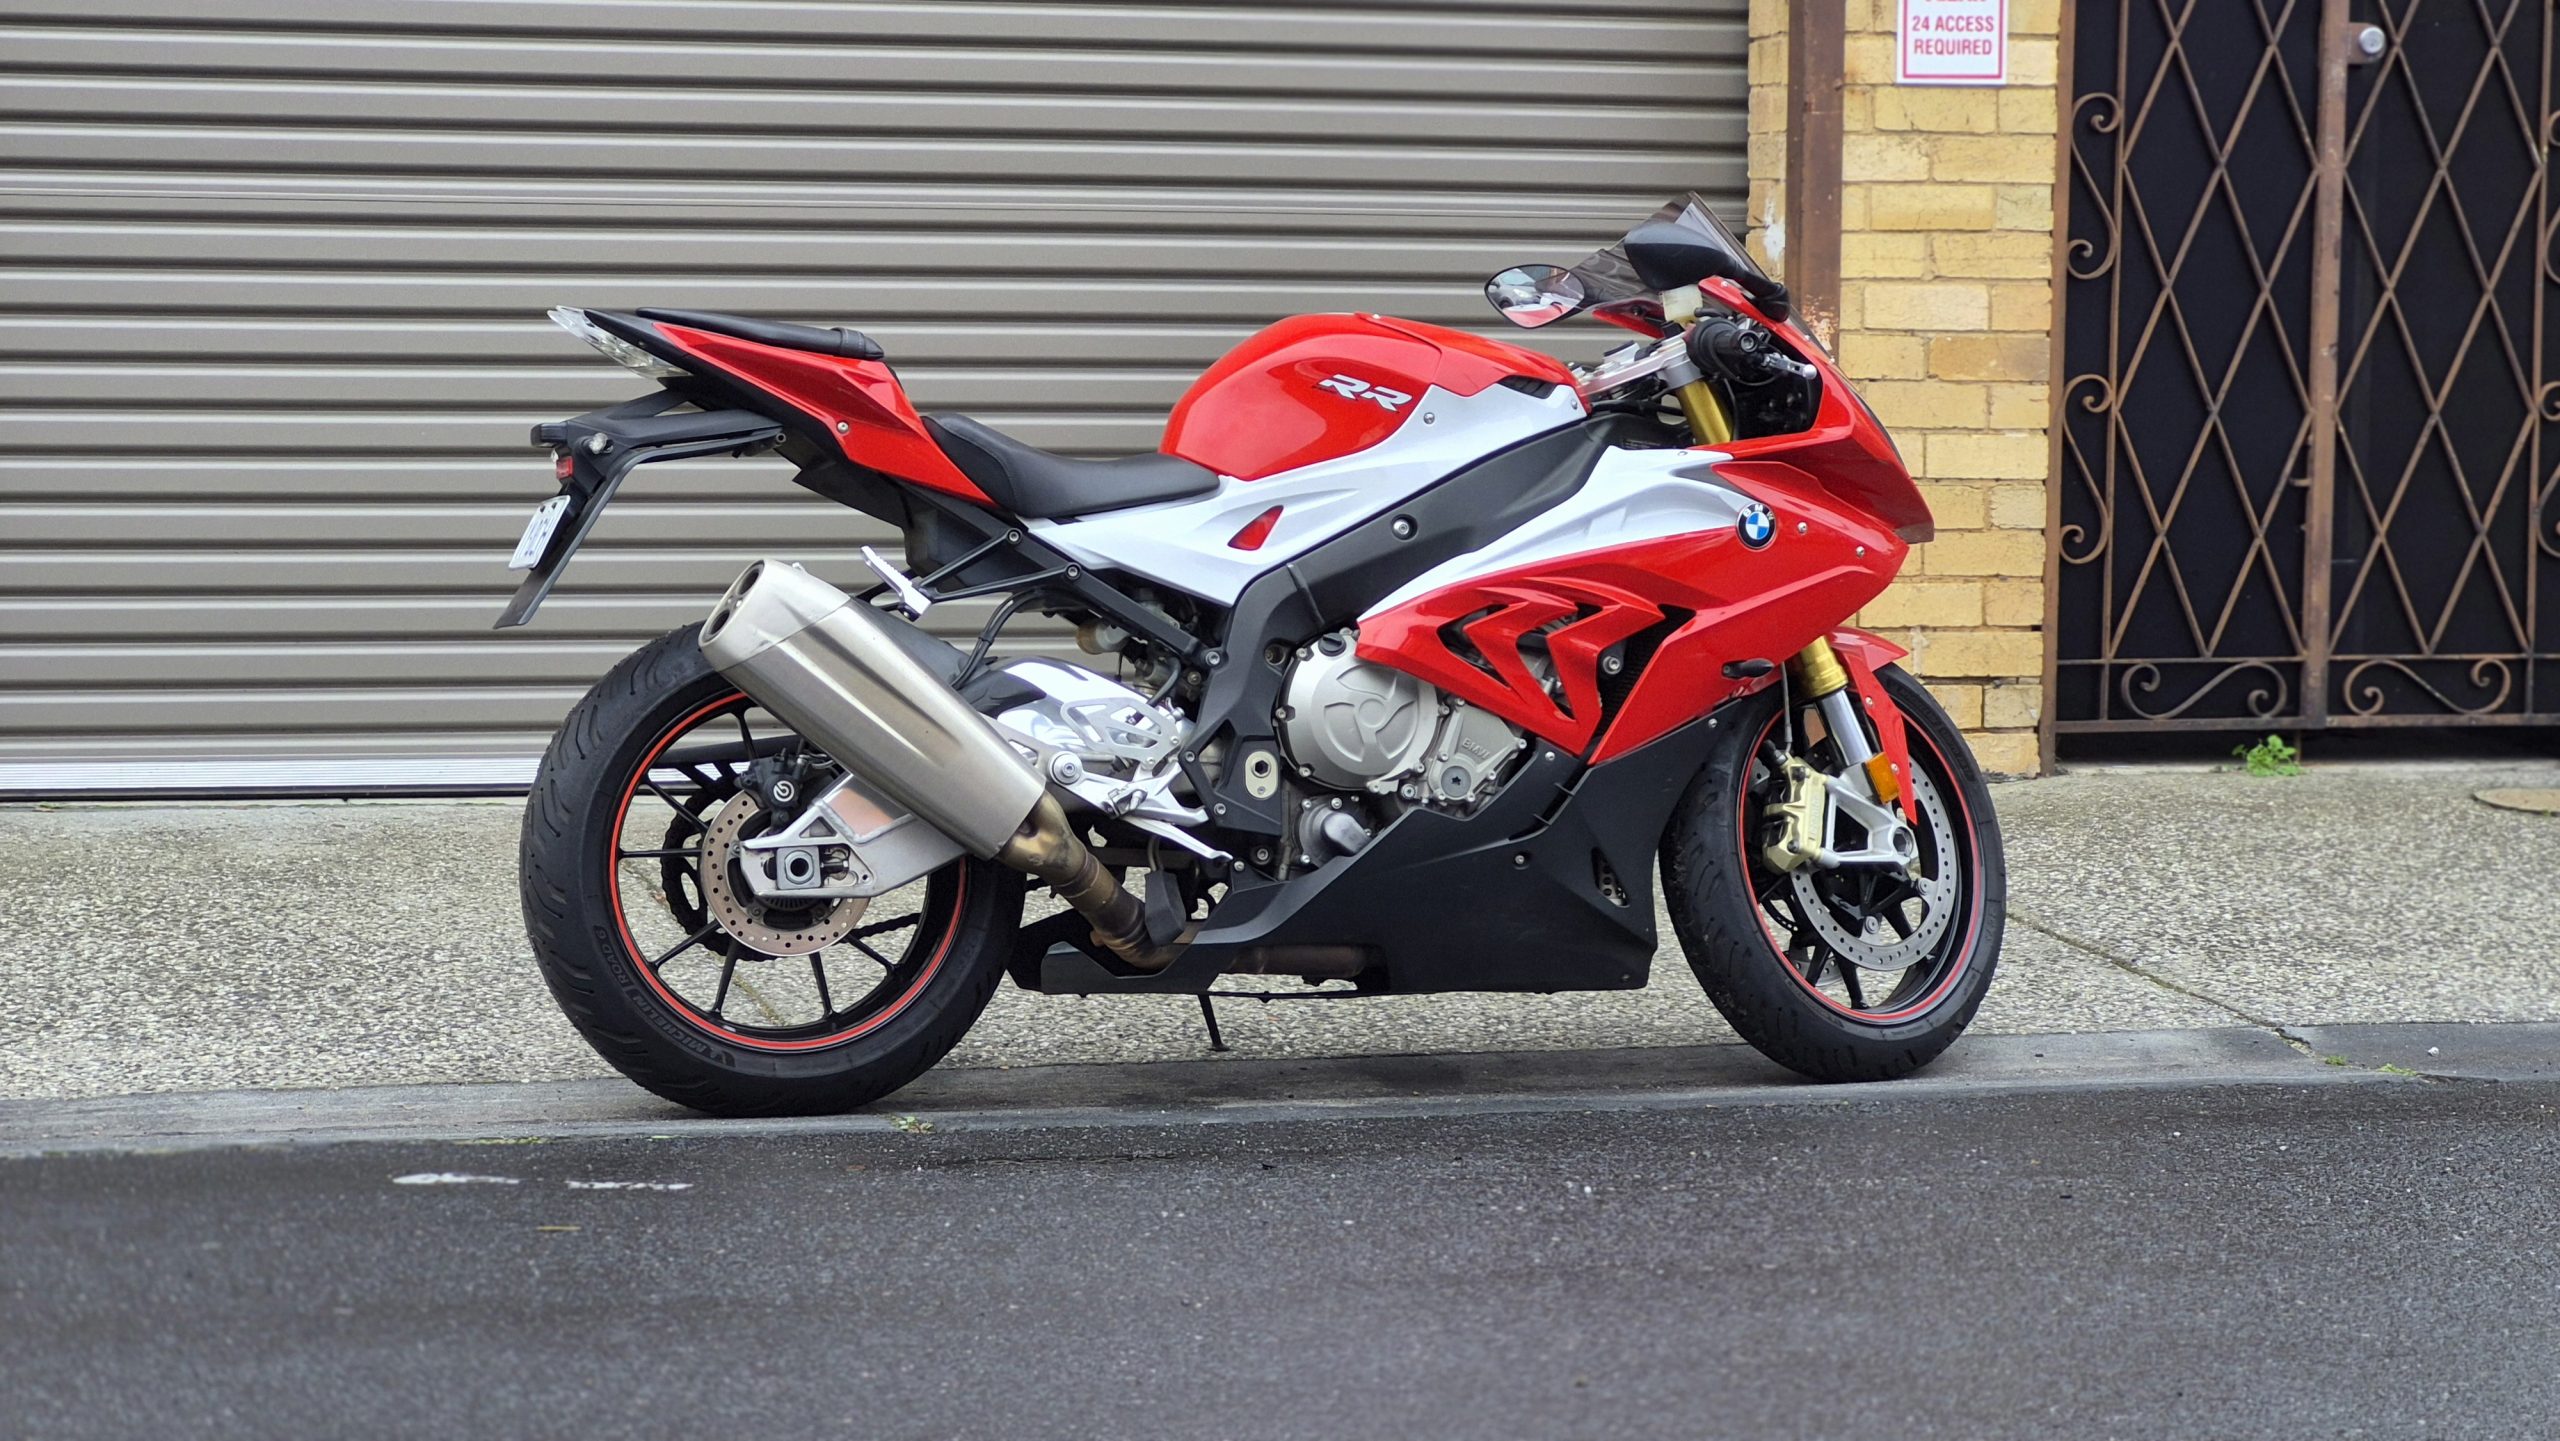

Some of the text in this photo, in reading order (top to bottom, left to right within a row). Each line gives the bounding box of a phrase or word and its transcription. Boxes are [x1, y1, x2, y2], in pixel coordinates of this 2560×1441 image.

[1912, 15, 1994, 32] 24 ACCESS
[1913, 39, 1993, 56] REQUIRED
[1318, 373, 1413, 412] RR
[1462, 737, 1490, 759] BMW
[602, 944, 629, 984] ROAD
[632, 995, 709, 1053] MICHELIN
